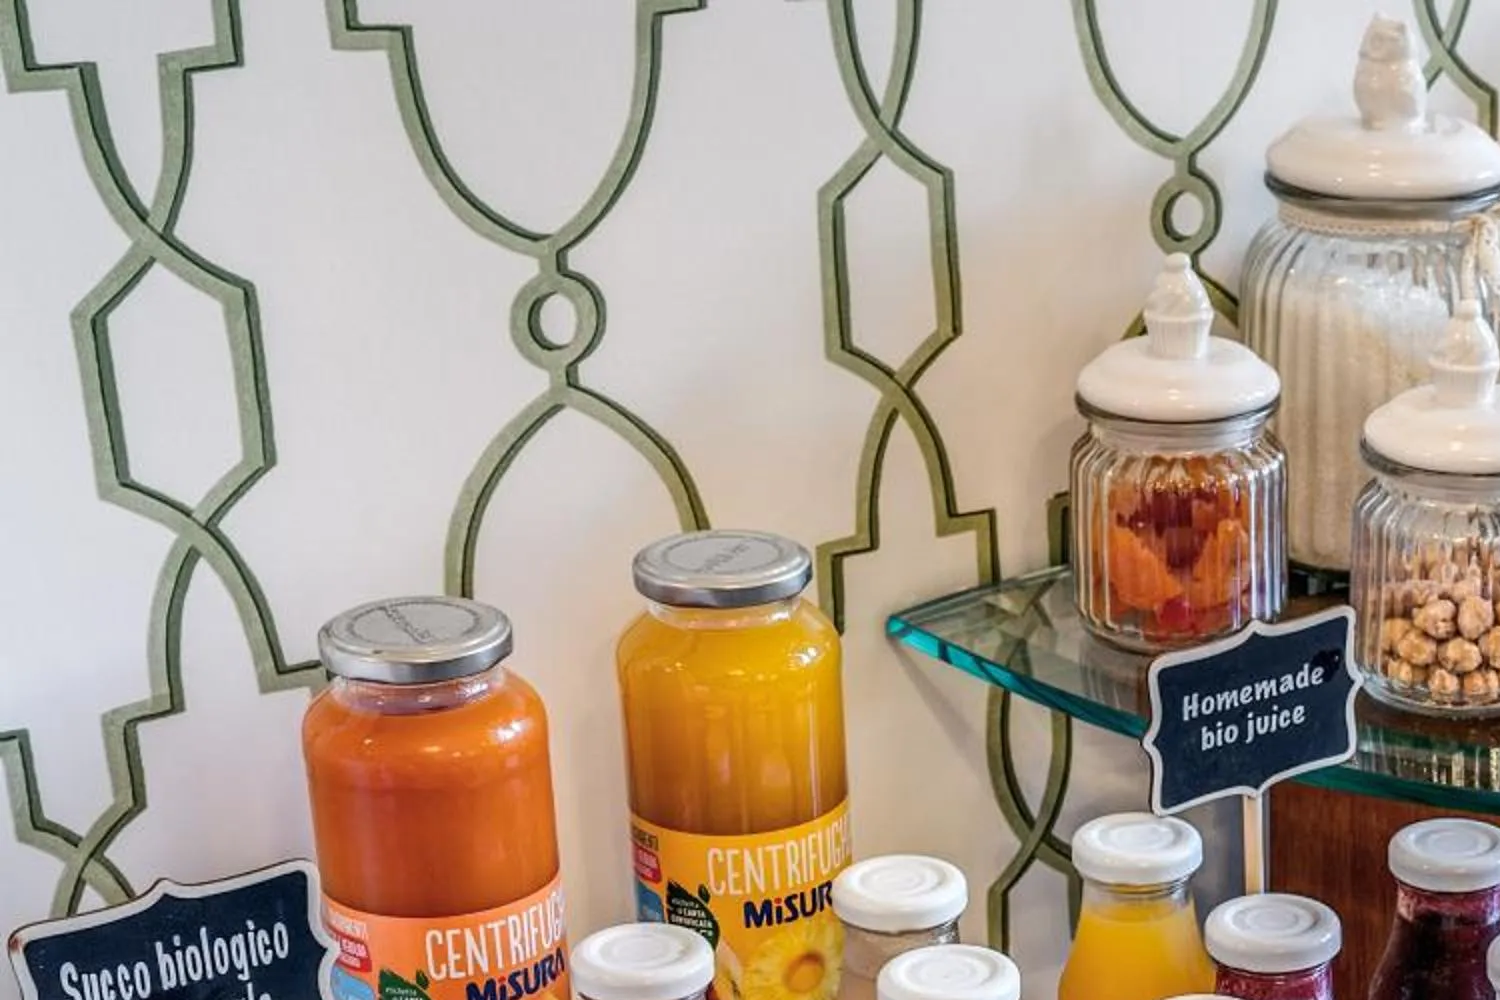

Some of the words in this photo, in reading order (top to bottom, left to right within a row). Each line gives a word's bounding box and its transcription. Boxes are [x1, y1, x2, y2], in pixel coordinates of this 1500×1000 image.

[1182, 662, 1324, 722] Homemade
[1201, 721, 1239, 751] bio
[1245, 705, 1306, 745] juice
[155, 919, 289, 991] biologico
